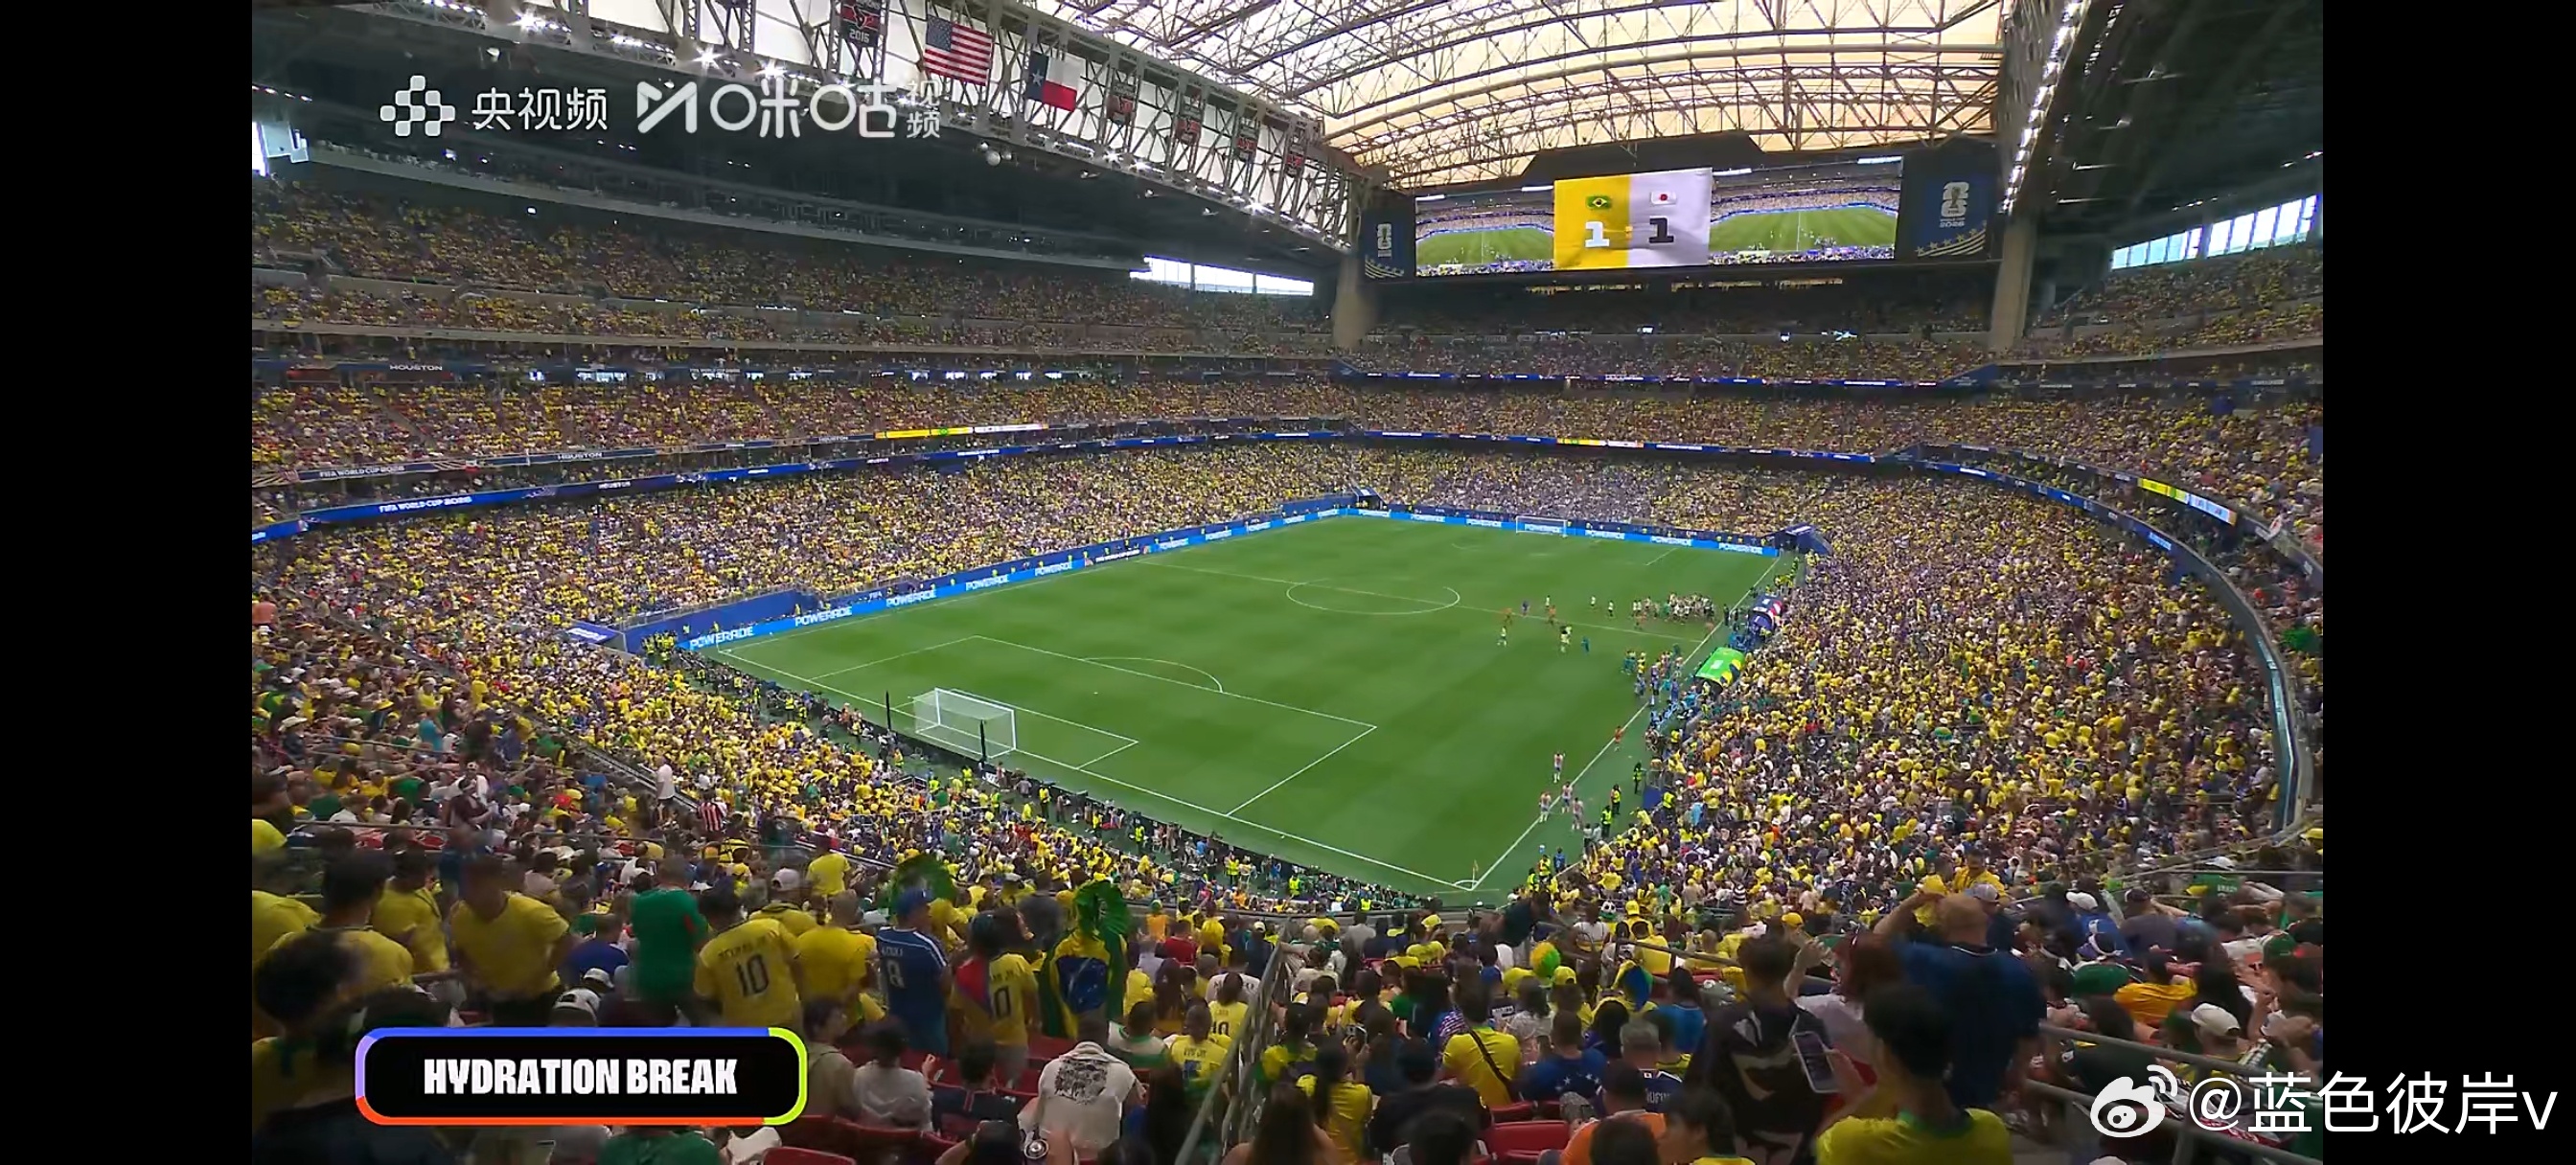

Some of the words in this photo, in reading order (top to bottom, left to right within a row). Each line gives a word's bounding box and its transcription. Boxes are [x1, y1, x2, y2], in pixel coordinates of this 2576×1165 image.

[1585, 221, 1610, 248] 1
[1648, 217, 1674, 243] 1
[886, 590, 936, 607] POWERADE
[795, 606, 853, 627] POWERADE
[690, 626, 754, 651] POWERADE
[736, 954, 770, 997] 10
